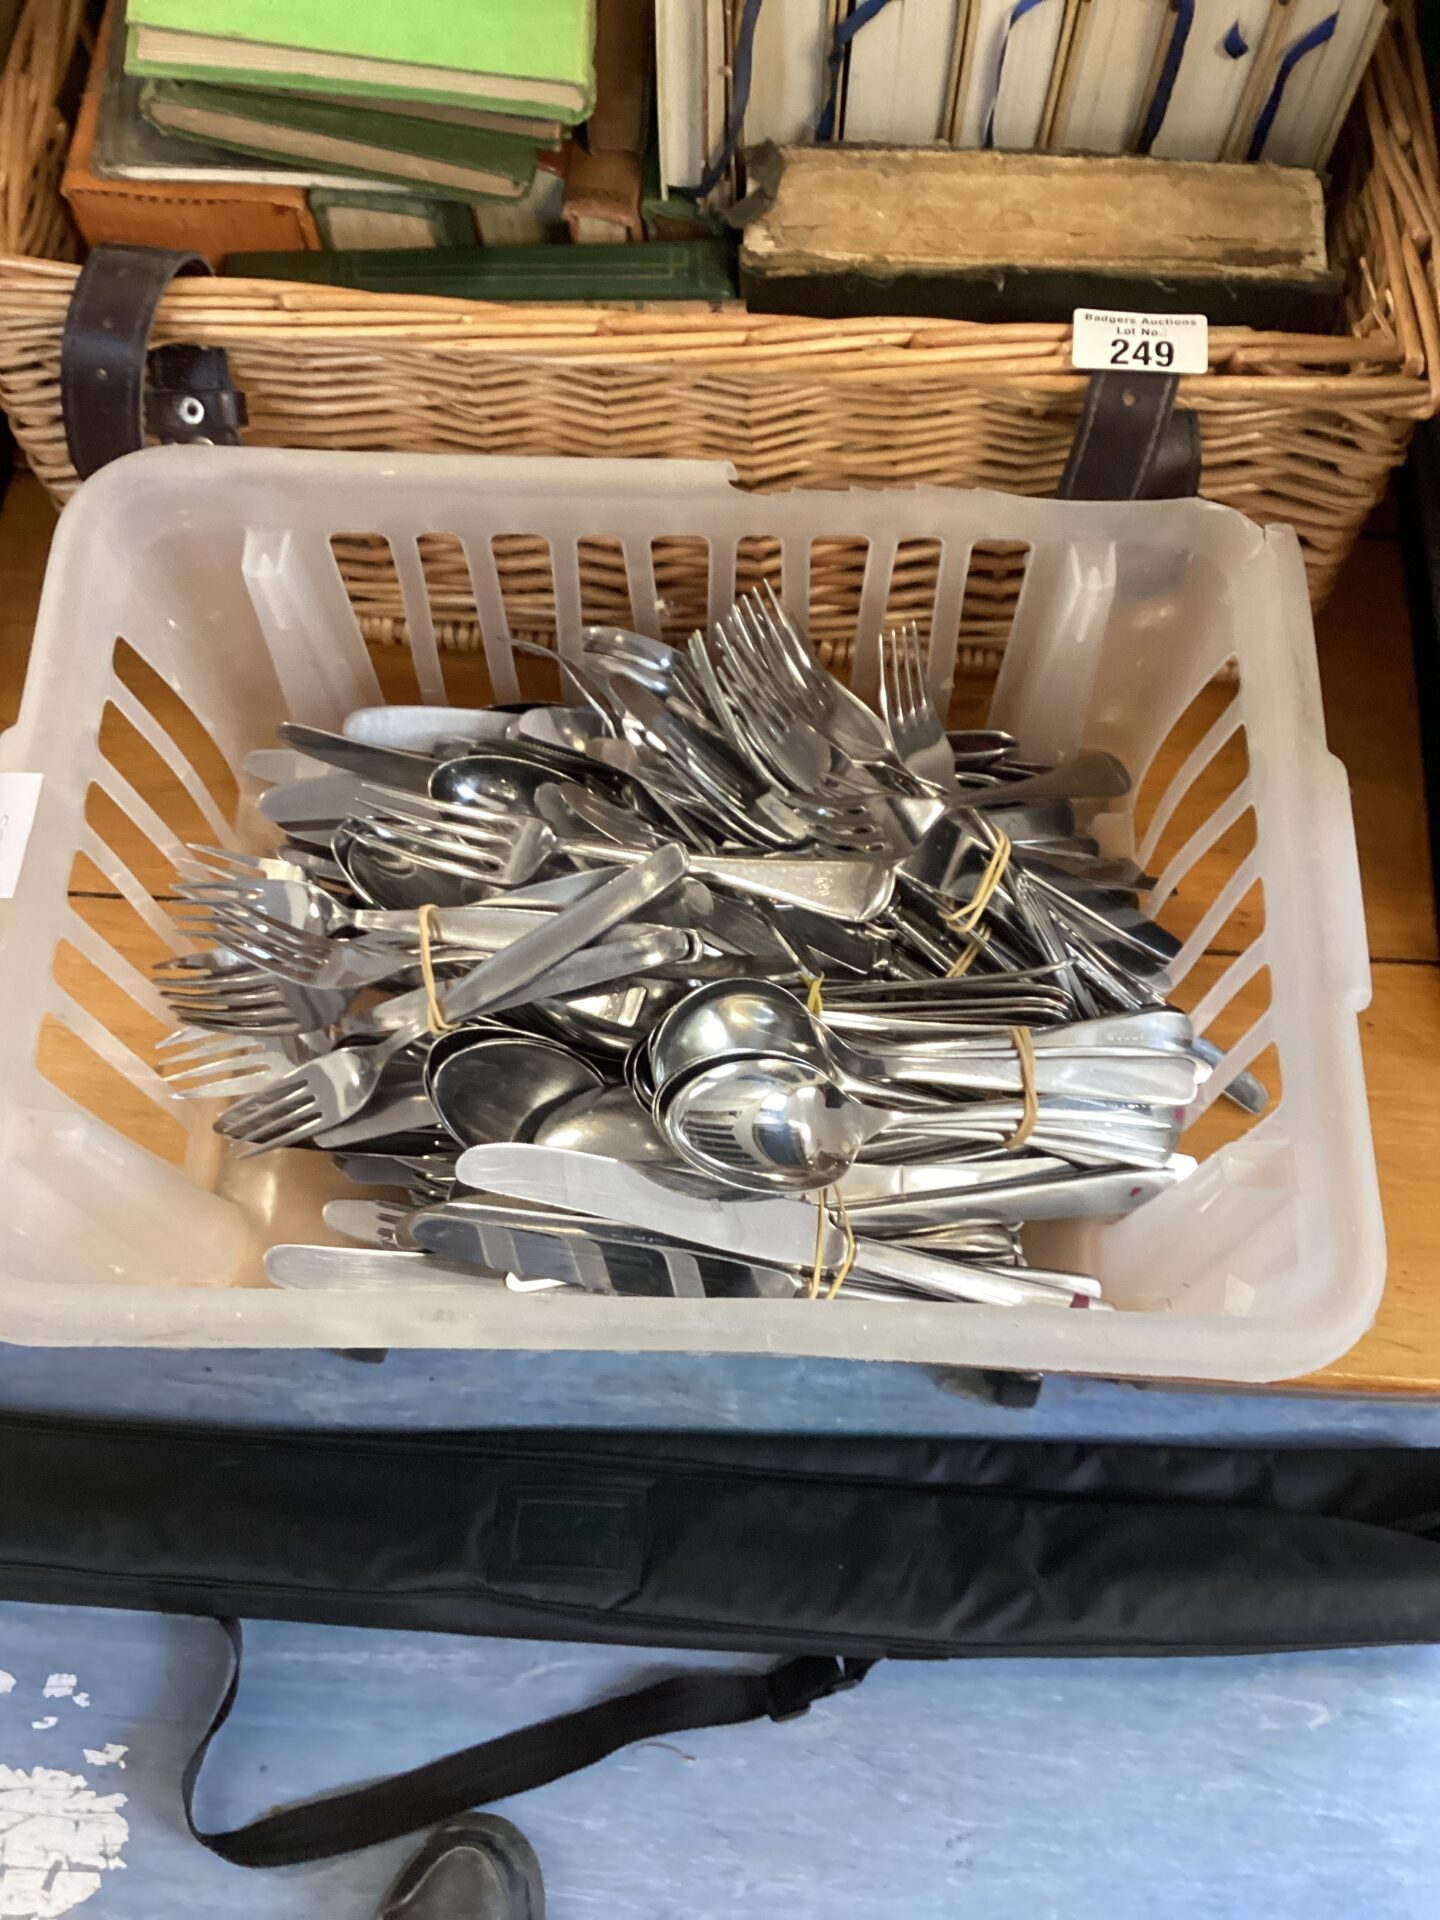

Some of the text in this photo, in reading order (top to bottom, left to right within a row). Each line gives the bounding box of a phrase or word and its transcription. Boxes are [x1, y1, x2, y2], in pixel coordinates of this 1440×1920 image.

[1085, 313, 1197, 326] Badgers Auctions
[1116, 326, 1136, 336] Lot
[1110, 338, 1175, 367] 249
